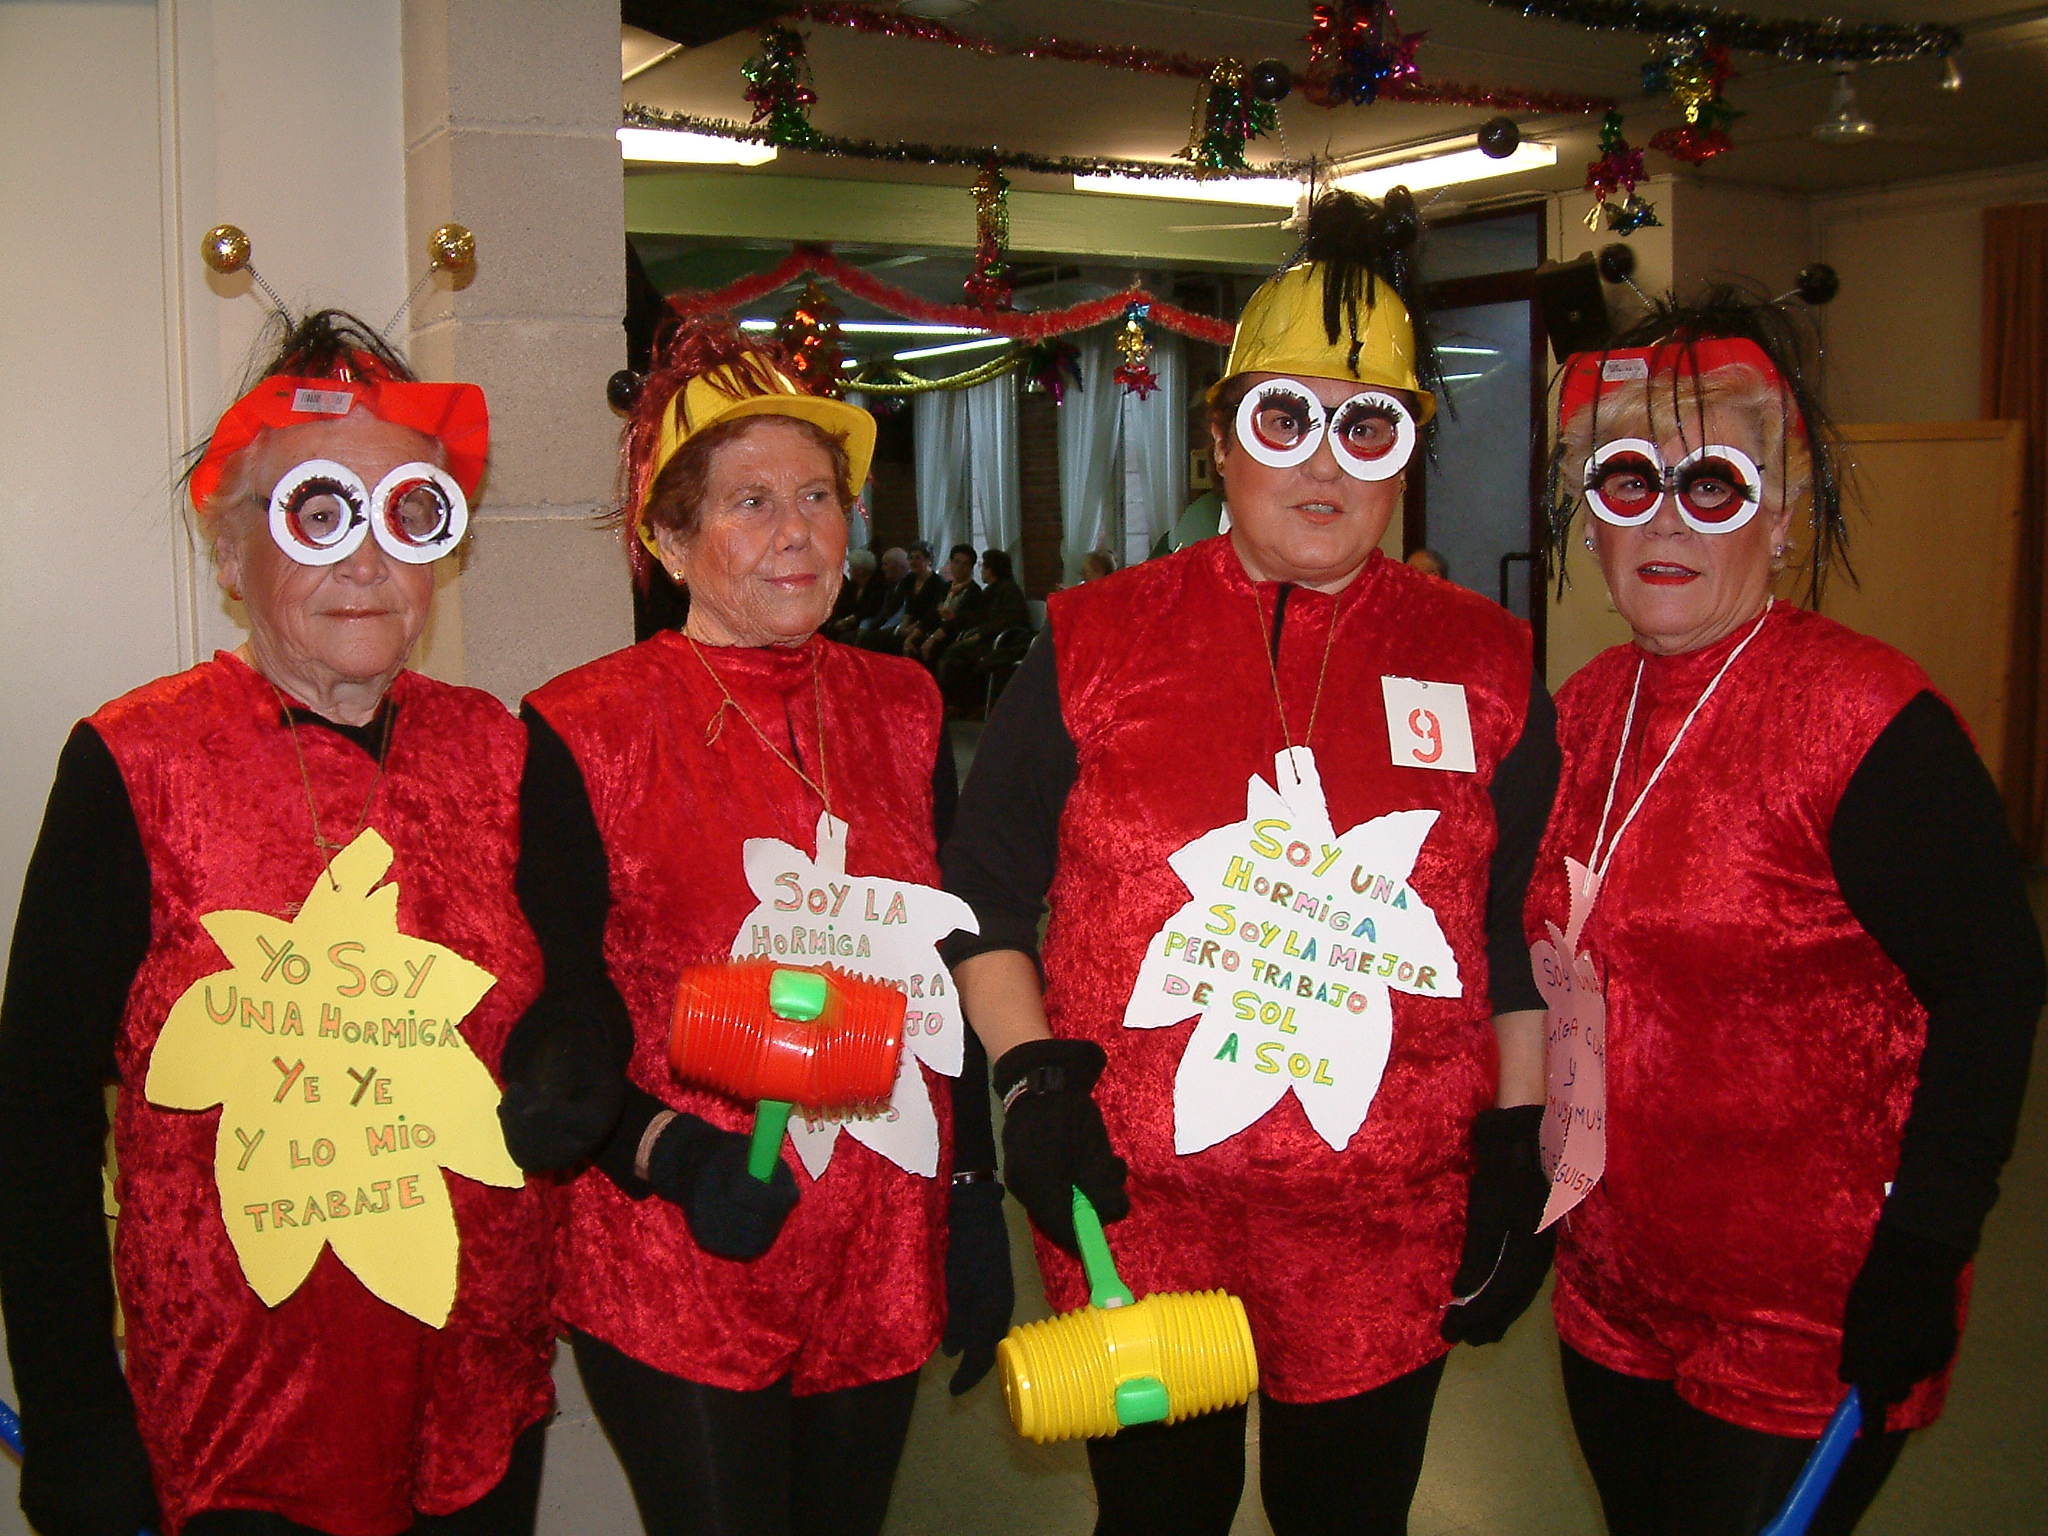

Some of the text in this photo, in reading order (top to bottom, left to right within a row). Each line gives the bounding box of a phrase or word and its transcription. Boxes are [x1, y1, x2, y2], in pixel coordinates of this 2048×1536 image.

[1408, 708, 1443, 764] 9
[1249, 819, 1407, 910] SOY UNA
[773, 872, 908, 925] SOY LA
[257, 935, 436, 999] YO SOY
[1163, 932, 1368, 1015] PERO TRABAJO
[1205, 904, 1438, 990] SOY LA MEJOR
[205, 985, 303, 1037] UNA
[1162, 973, 1298, 1036] DE SOL
[272, 1055, 393, 1106] YE YE
[1213, 1032, 1334, 1087] A SOL
[235, 1127, 265, 1172] Y
[289, 1137, 336, 1168] LO
[245, 1174, 425, 1232] TRABAJE
